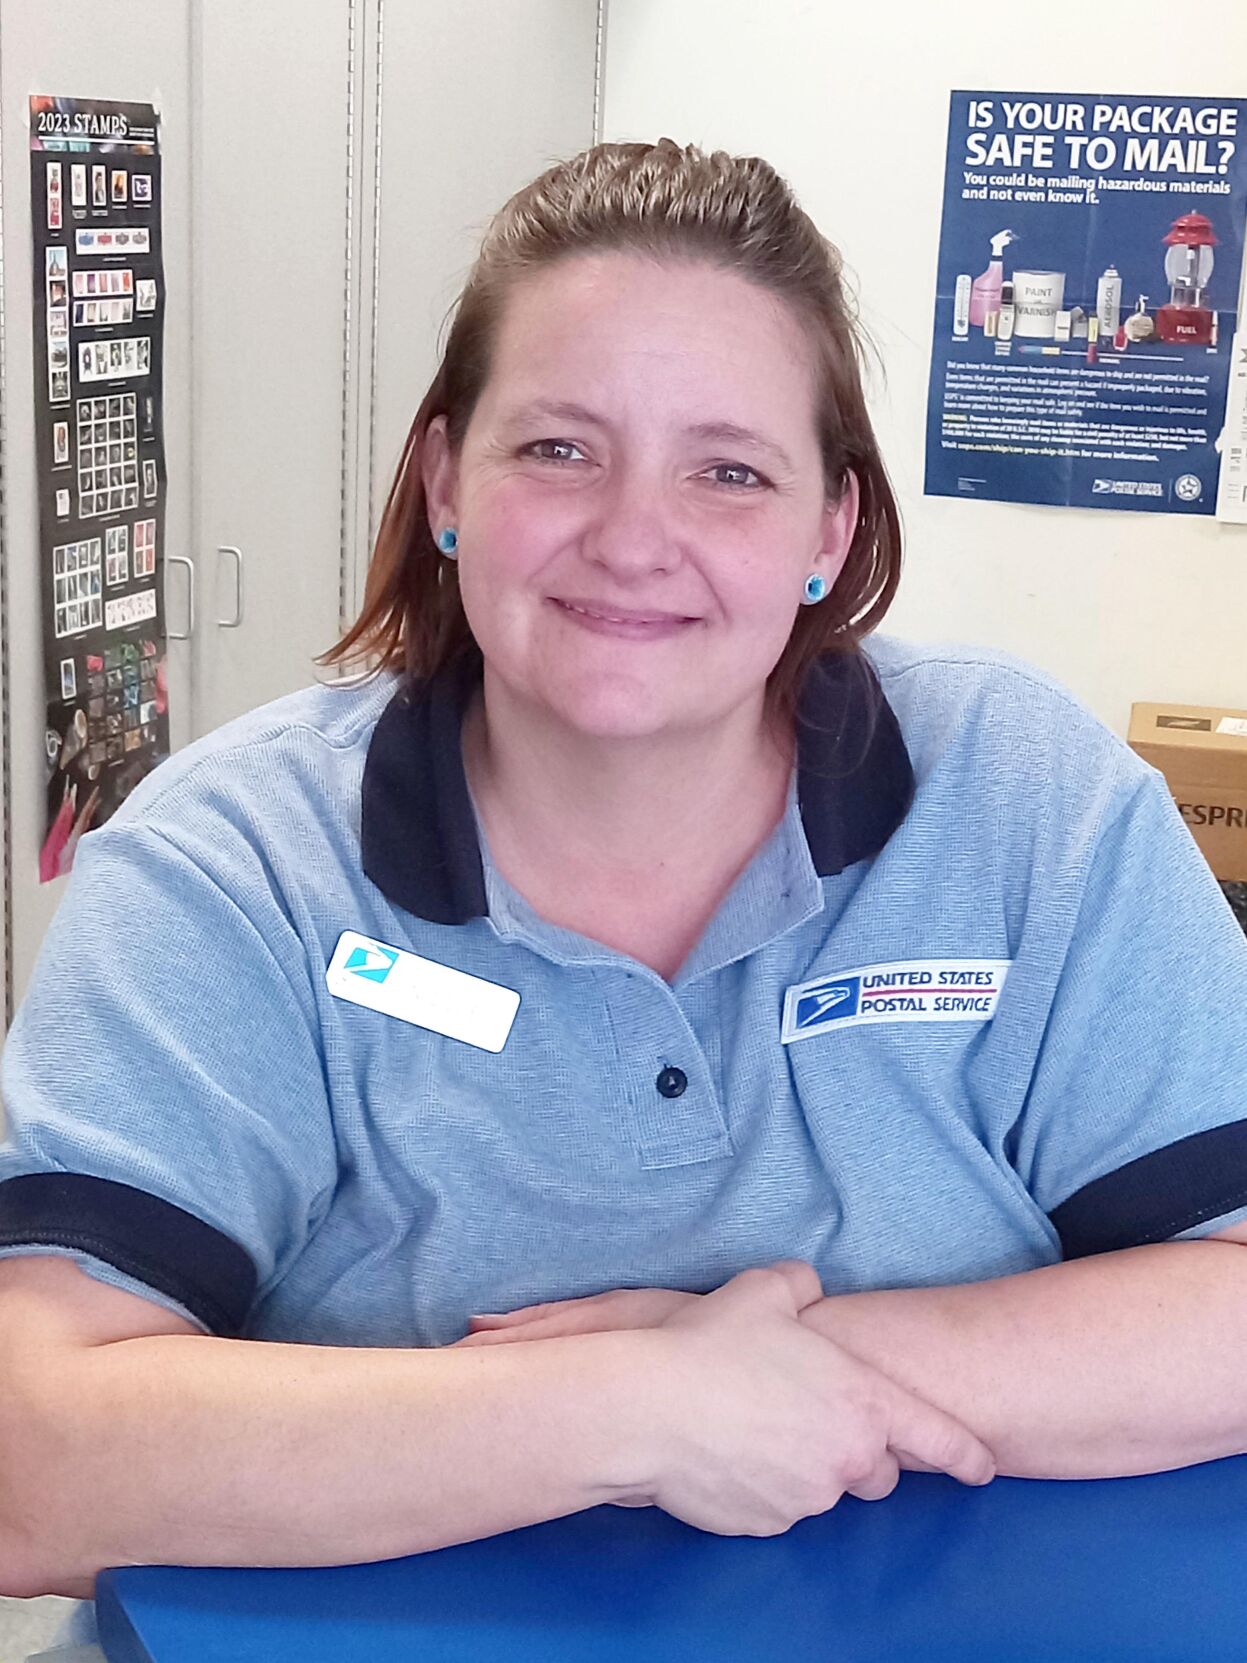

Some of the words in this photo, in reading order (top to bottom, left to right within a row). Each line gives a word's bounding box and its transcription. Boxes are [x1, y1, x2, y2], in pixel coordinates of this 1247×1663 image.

[37, 112, 70, 133] 2023
[73, 113, 128, 136] STAMPS
[968, 101, 993, 128] IS
[1001, 101, 1085, 131] YOUR
[1093, 104, 1238, 136] PACKAGE
[965, 132, 1055, 168] SAFE
[1064, 136, 1117, 171] TO
[1123, 138, 1236, 175] MAIL?
[963, 172, 987, 186] You
[989, 172, 1025, 187] could
[1028, 173, 1046, 188] be
[1047, 175, 1095, 191] mailing
[1098, 176, 1167, 193] hazardous
[1169, 178, 1231, 194] materials
[962, 187, 987, 200] and
[989, 188, 1012, 201] not
[1014, 190, 1047, 202] even
[1048, 189, 1084, 203] know
[1086, 190, 1100, 204] it.
[1025, 287, 1053, 296] PAINT
[1176, 325, 1198, 334] FUEL
[1178, 803, 1247, 828] ESPR
[862, 972, 932, 988] UNITED
[938, 971, 994, 985] STATES
[861, 997, 927, 1014] POSTAL
[934, 997, 992, 1012] SERVICE
